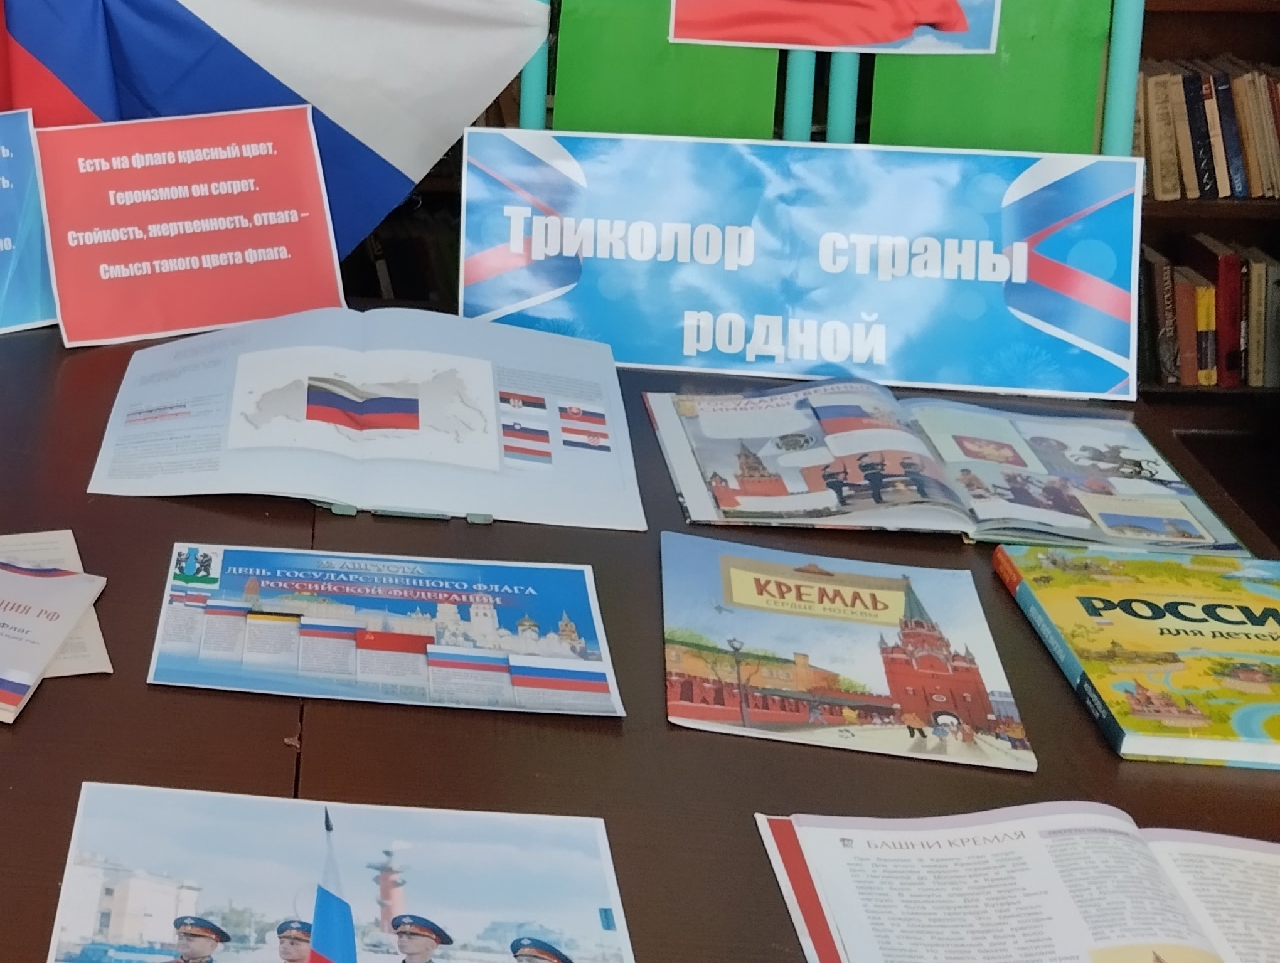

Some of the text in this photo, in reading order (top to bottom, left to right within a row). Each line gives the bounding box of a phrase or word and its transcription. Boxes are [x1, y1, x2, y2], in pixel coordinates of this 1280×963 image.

[78, 141, 277, 173] Есть на флаге красный цвет.
[109, 178, 259, 206] Героизмом он согрет.
[67, 226, 147, 248] Стойкость,
[148, 216, 253, 239] жертвенность,
[253, 209, 298, 227] отвага
[503, 206, 1028, 284] Триколор страны
[99, 245, 292, 280] Смысл такого цвета флага.
[683, 310, 887, 366] родной
[225, 565, 540, 597] ДЕНЬ ГОСУДАРСТВЕННОГО ФЛАГА
[339, 561, 424, 575] АВГУСТА
[260, 579, 503, 606] РОССИЙСКОЙ ФЕДЕРАЦИИ
[753, 577, 890, 611] КРЕМЛЬ
[36, 607, 61, 623] РФ
[765, 599, 879, 619] СЕРДЦЕ МОСКВЫ
[1076, 596, 1280, 627] РОССИ
[1158, 626, 1205, 637] для
[866, 830, 1026, 850] БАШНИ КРЕМЛЯ
